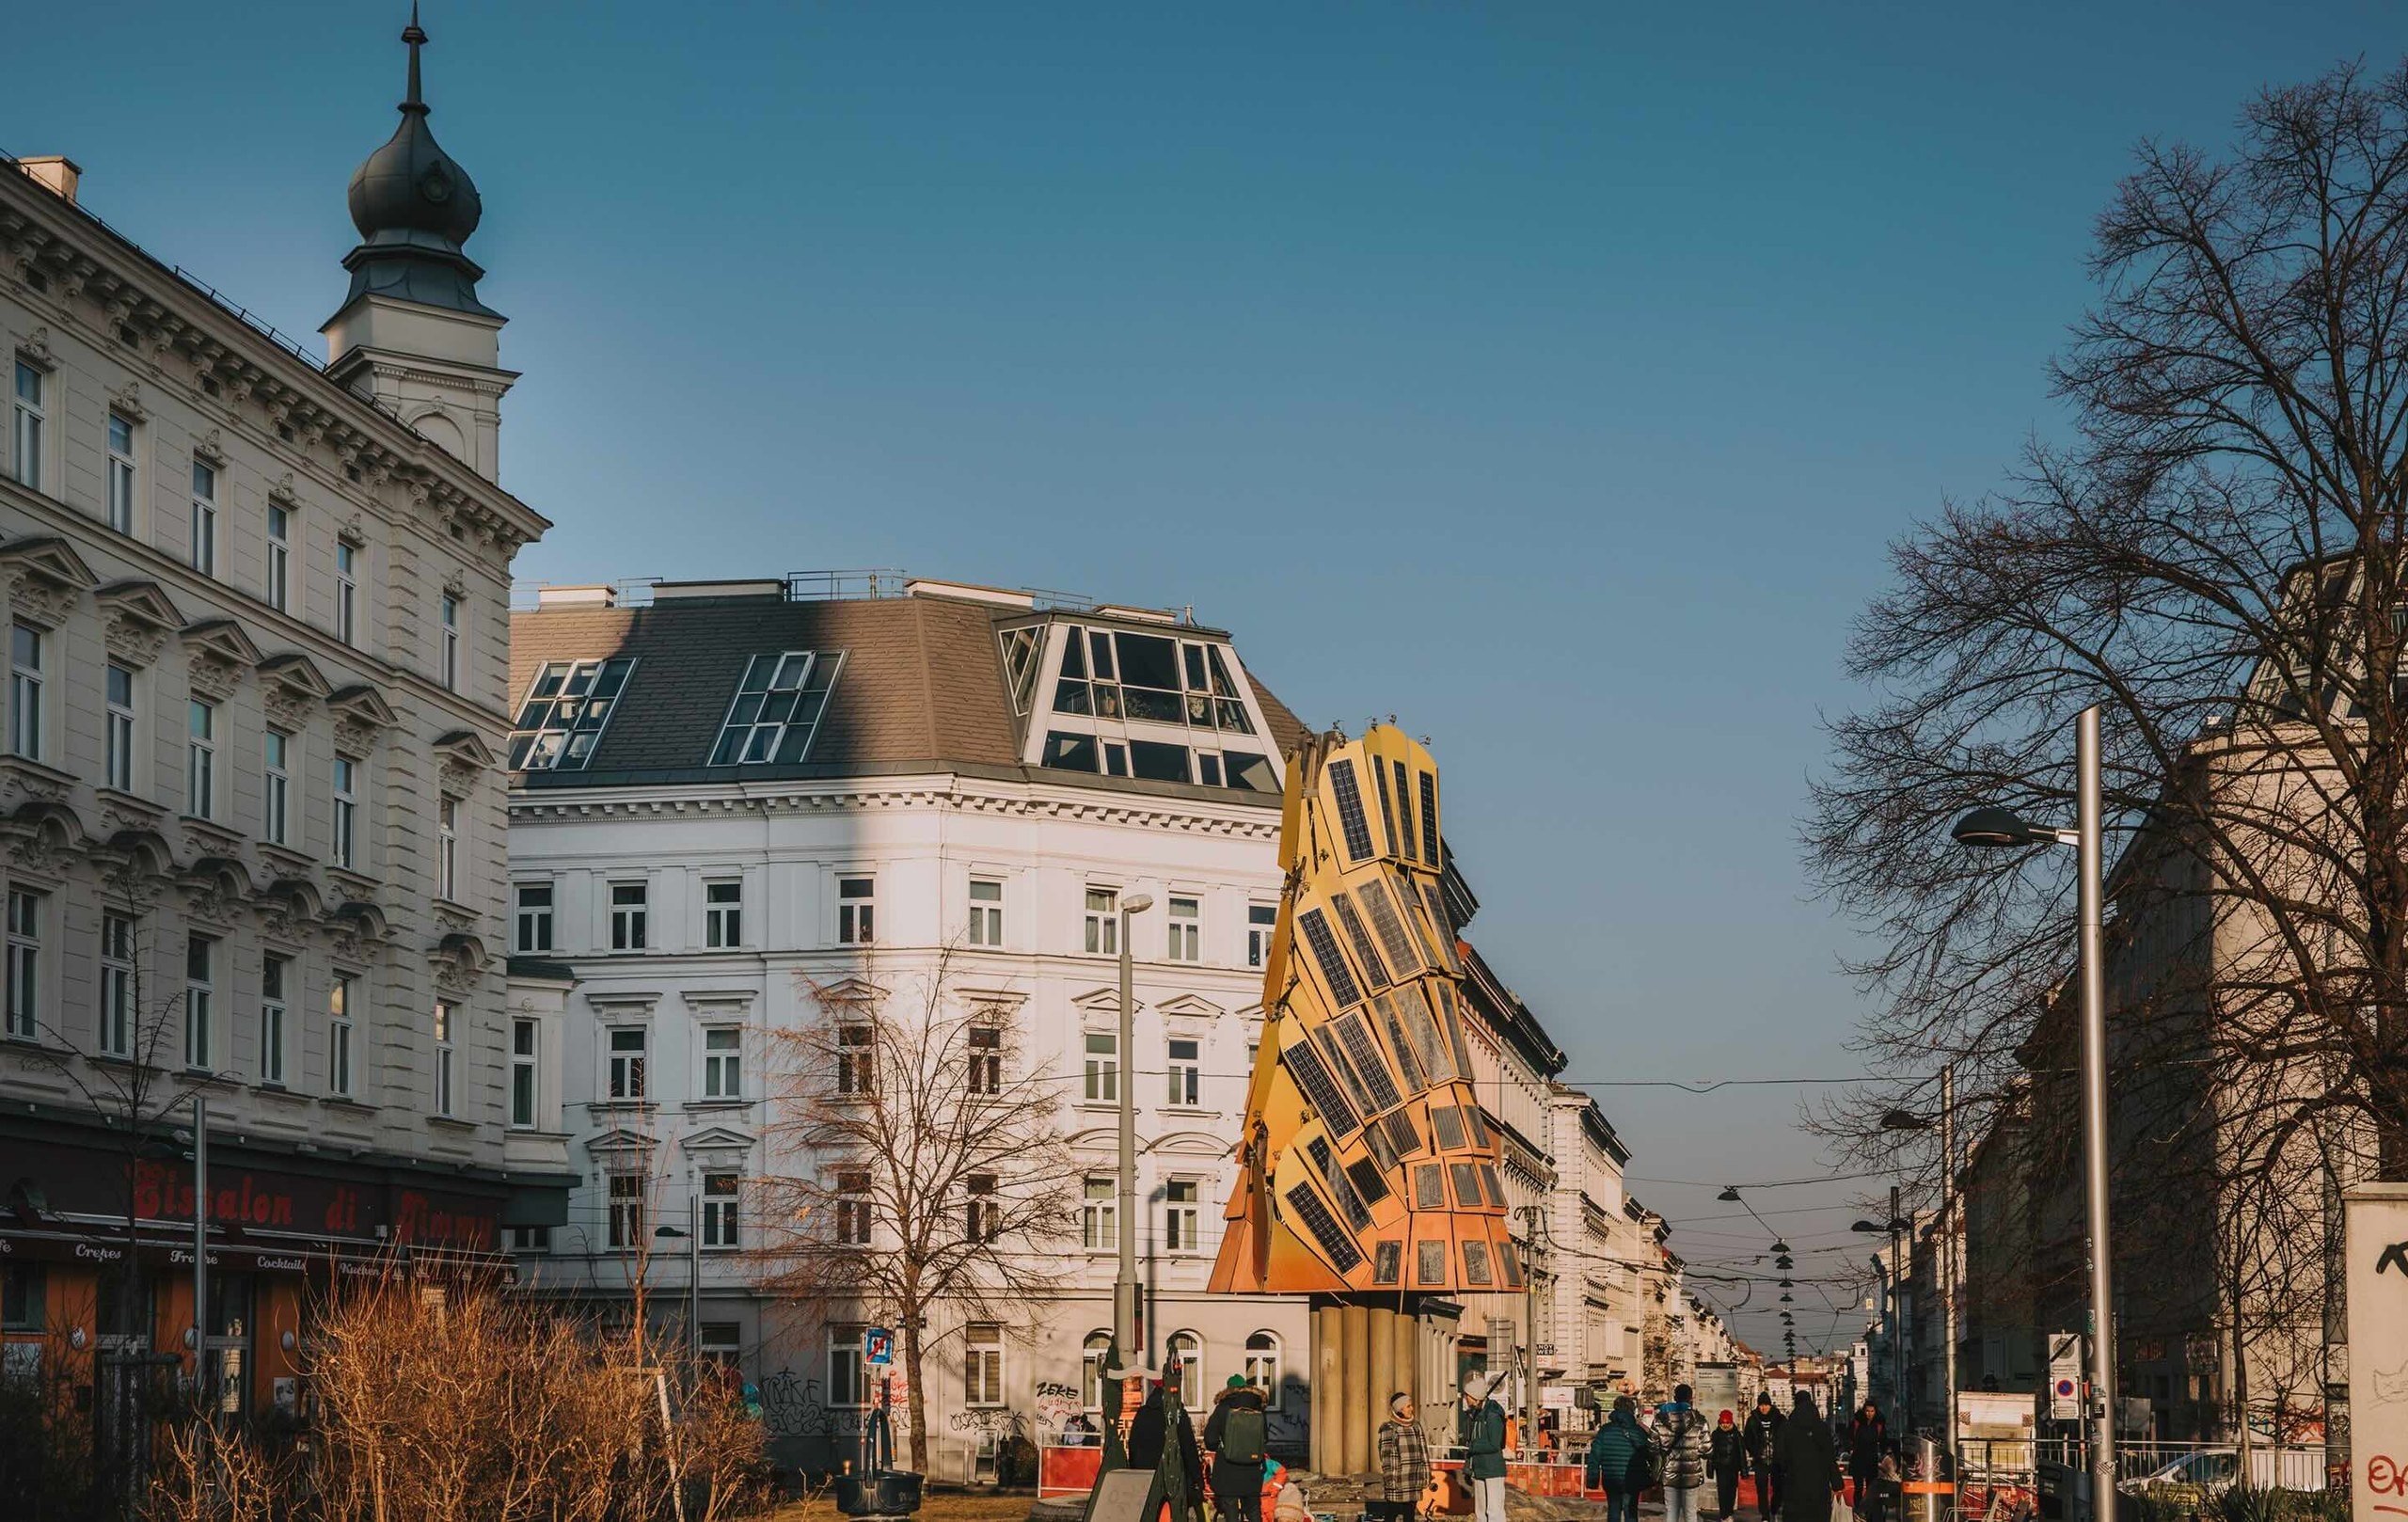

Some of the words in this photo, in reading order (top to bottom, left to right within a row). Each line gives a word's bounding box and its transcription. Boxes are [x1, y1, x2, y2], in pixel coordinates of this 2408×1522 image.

[325, 1187, 357, 1232] di
[257, 1255, 306, 1271] Cocktails
[339, 1261, 381, 1277] Kuchen
[1037, 1381, 1079, 1400] ZEKE
